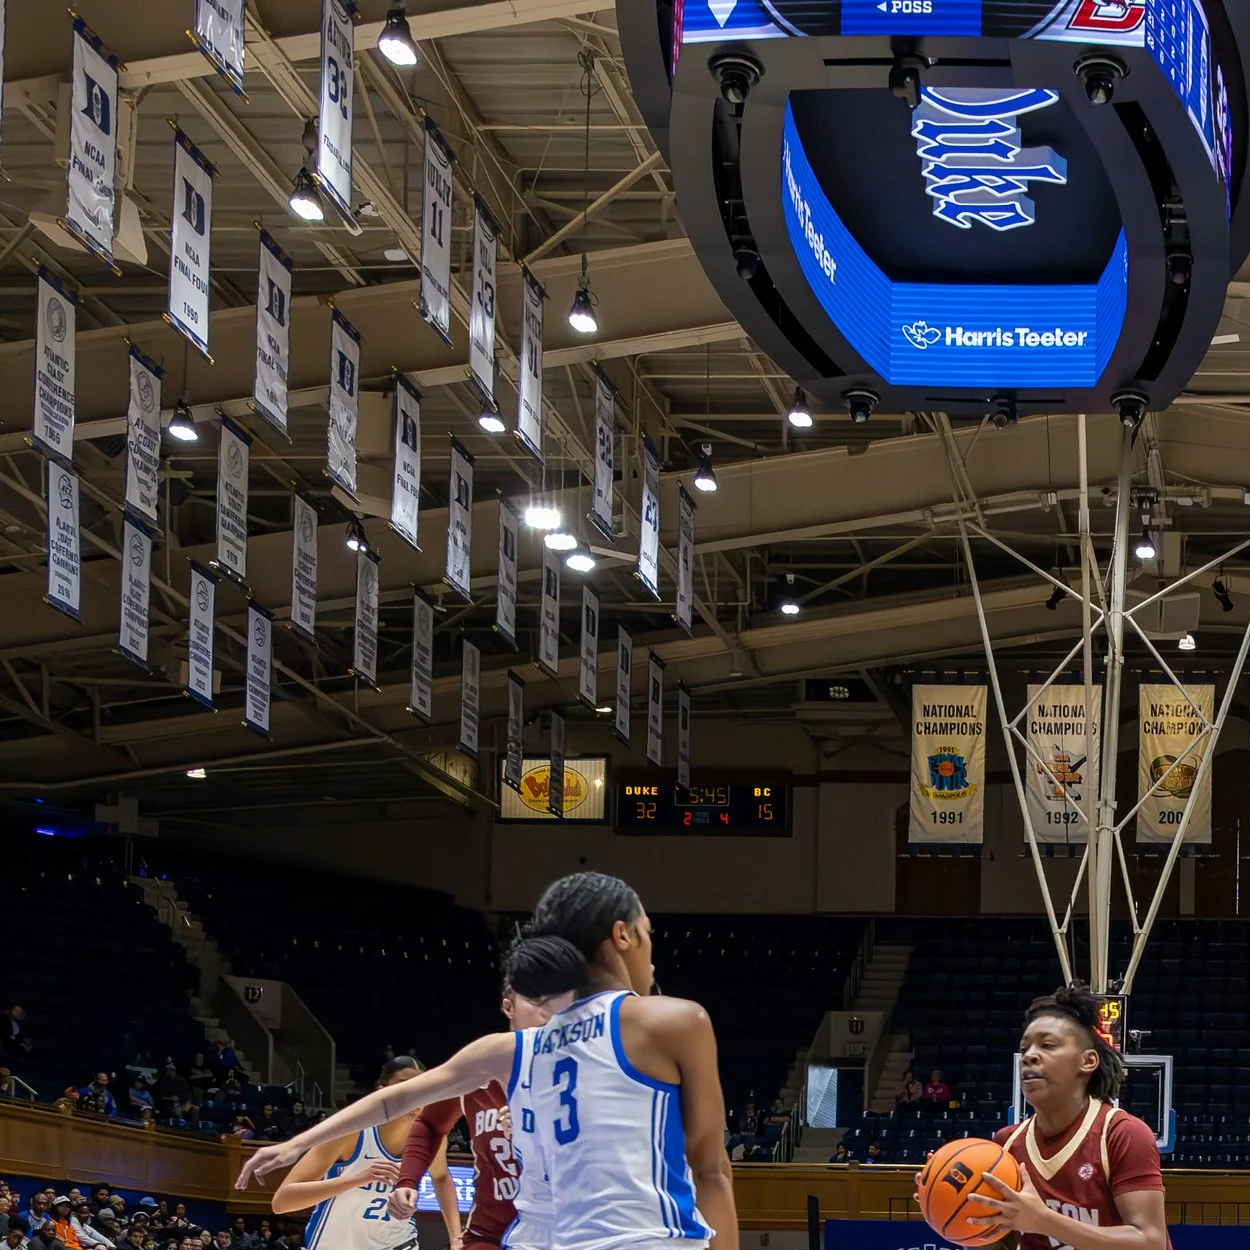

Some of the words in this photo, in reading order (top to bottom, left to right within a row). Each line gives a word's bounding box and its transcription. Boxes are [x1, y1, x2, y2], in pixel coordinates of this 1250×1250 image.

[891, 0, 933, 13] POSS
[85, 140, 106, 170] NCAA
[430, 201, 444, 249] 11
[182, 301, 199, 324] 1990
[945, 327, 1013, 347] Harris
[1014, 327, 1087, 347] Teeter
[923, 704, 977, 719] NATIONAL
[1037, 704, 1086, 719] NATIONA
[915, 722, 984, 736] CHAMPIONS
[1143, 721, 1206, 736] CHAMPION
[625, 786, 659, 796] DUKE
[636, 802, 657, 819] 32
[758, 803, 773, 820] 15
[930, 810, 963, 825] 1991
[1046, 811, 1080, 825] 1992
[1158, 810, 1191, 825] 200
[551, 1056, 581, 1146] 3
